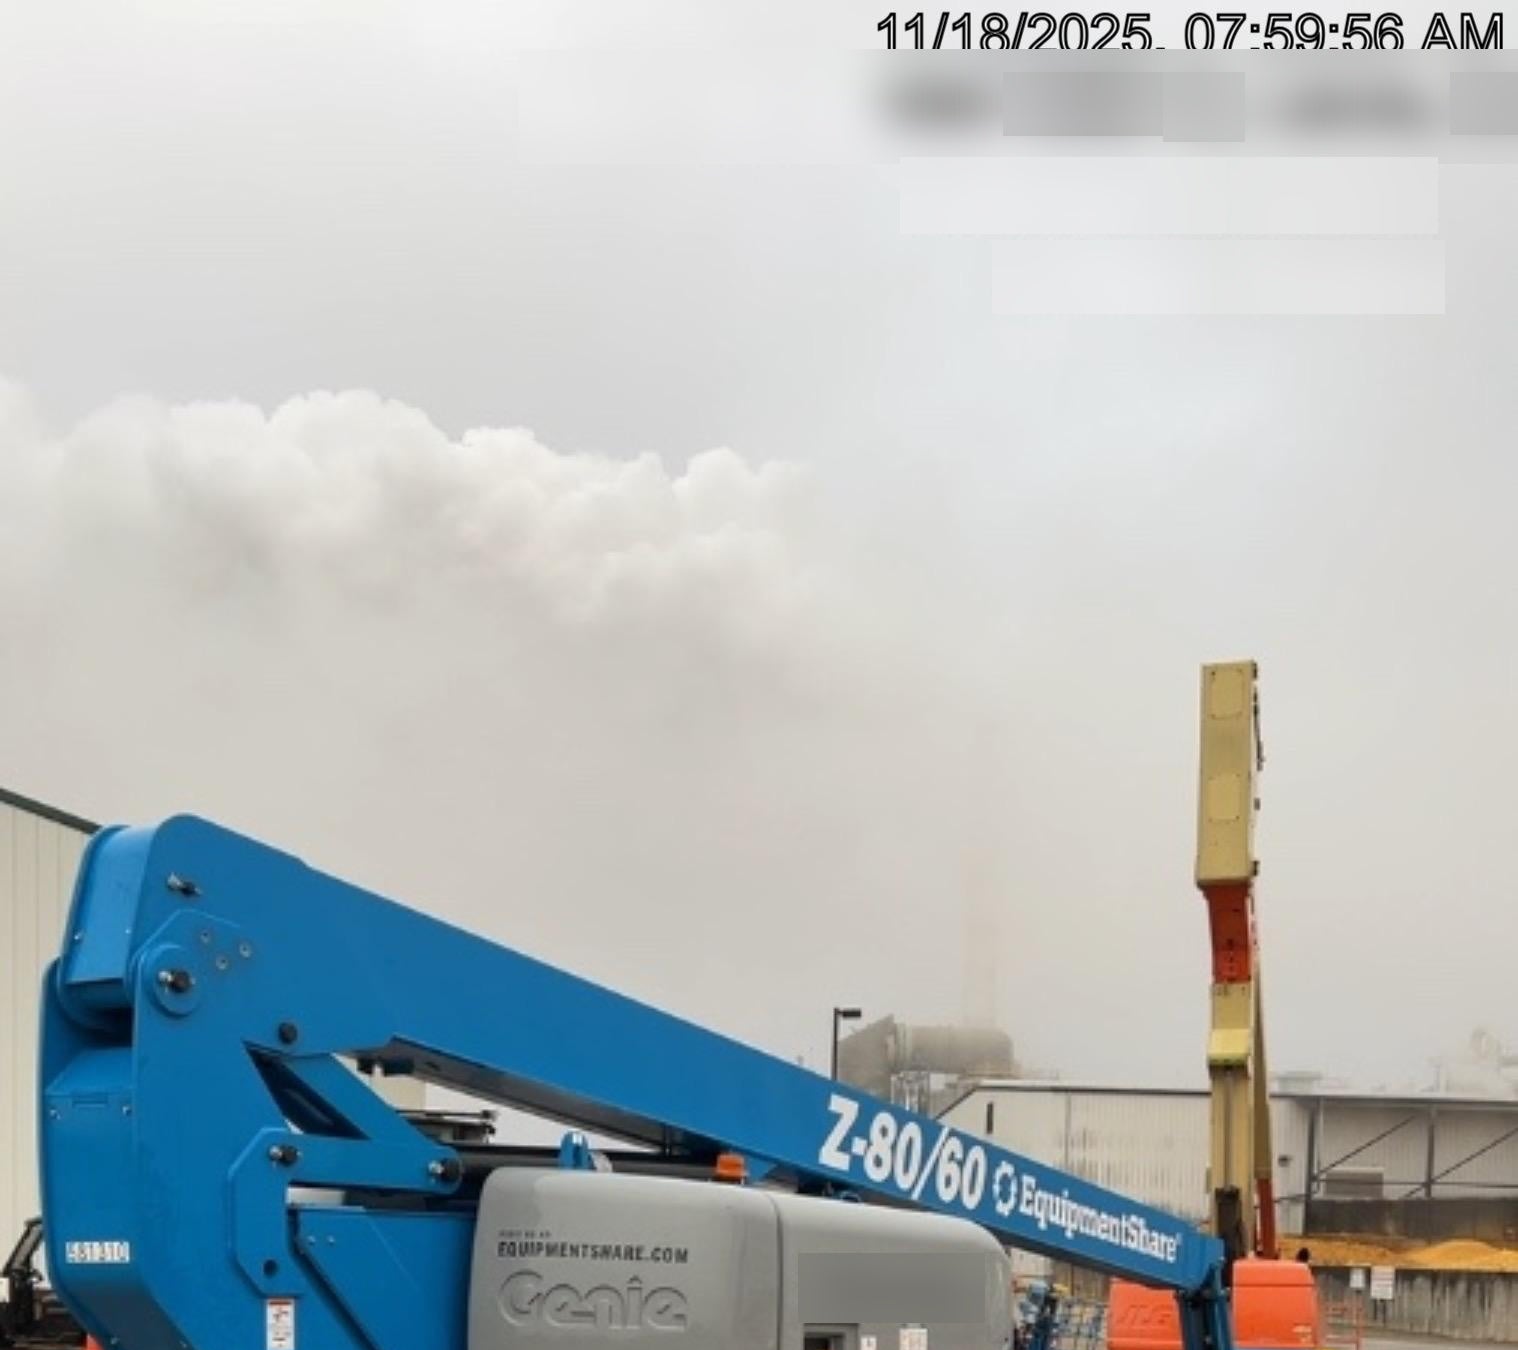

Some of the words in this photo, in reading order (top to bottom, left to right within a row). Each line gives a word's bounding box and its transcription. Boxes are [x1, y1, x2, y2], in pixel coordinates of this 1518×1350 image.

[818, 1094, 988, 1210] Z-80/60
[497, 1241, 689, 1264] EQUIPMENTSHARE.COM
[1019, 1174, 1178, 1264] EquipmentShare
[499, 1268, 688, 1331] Genie
